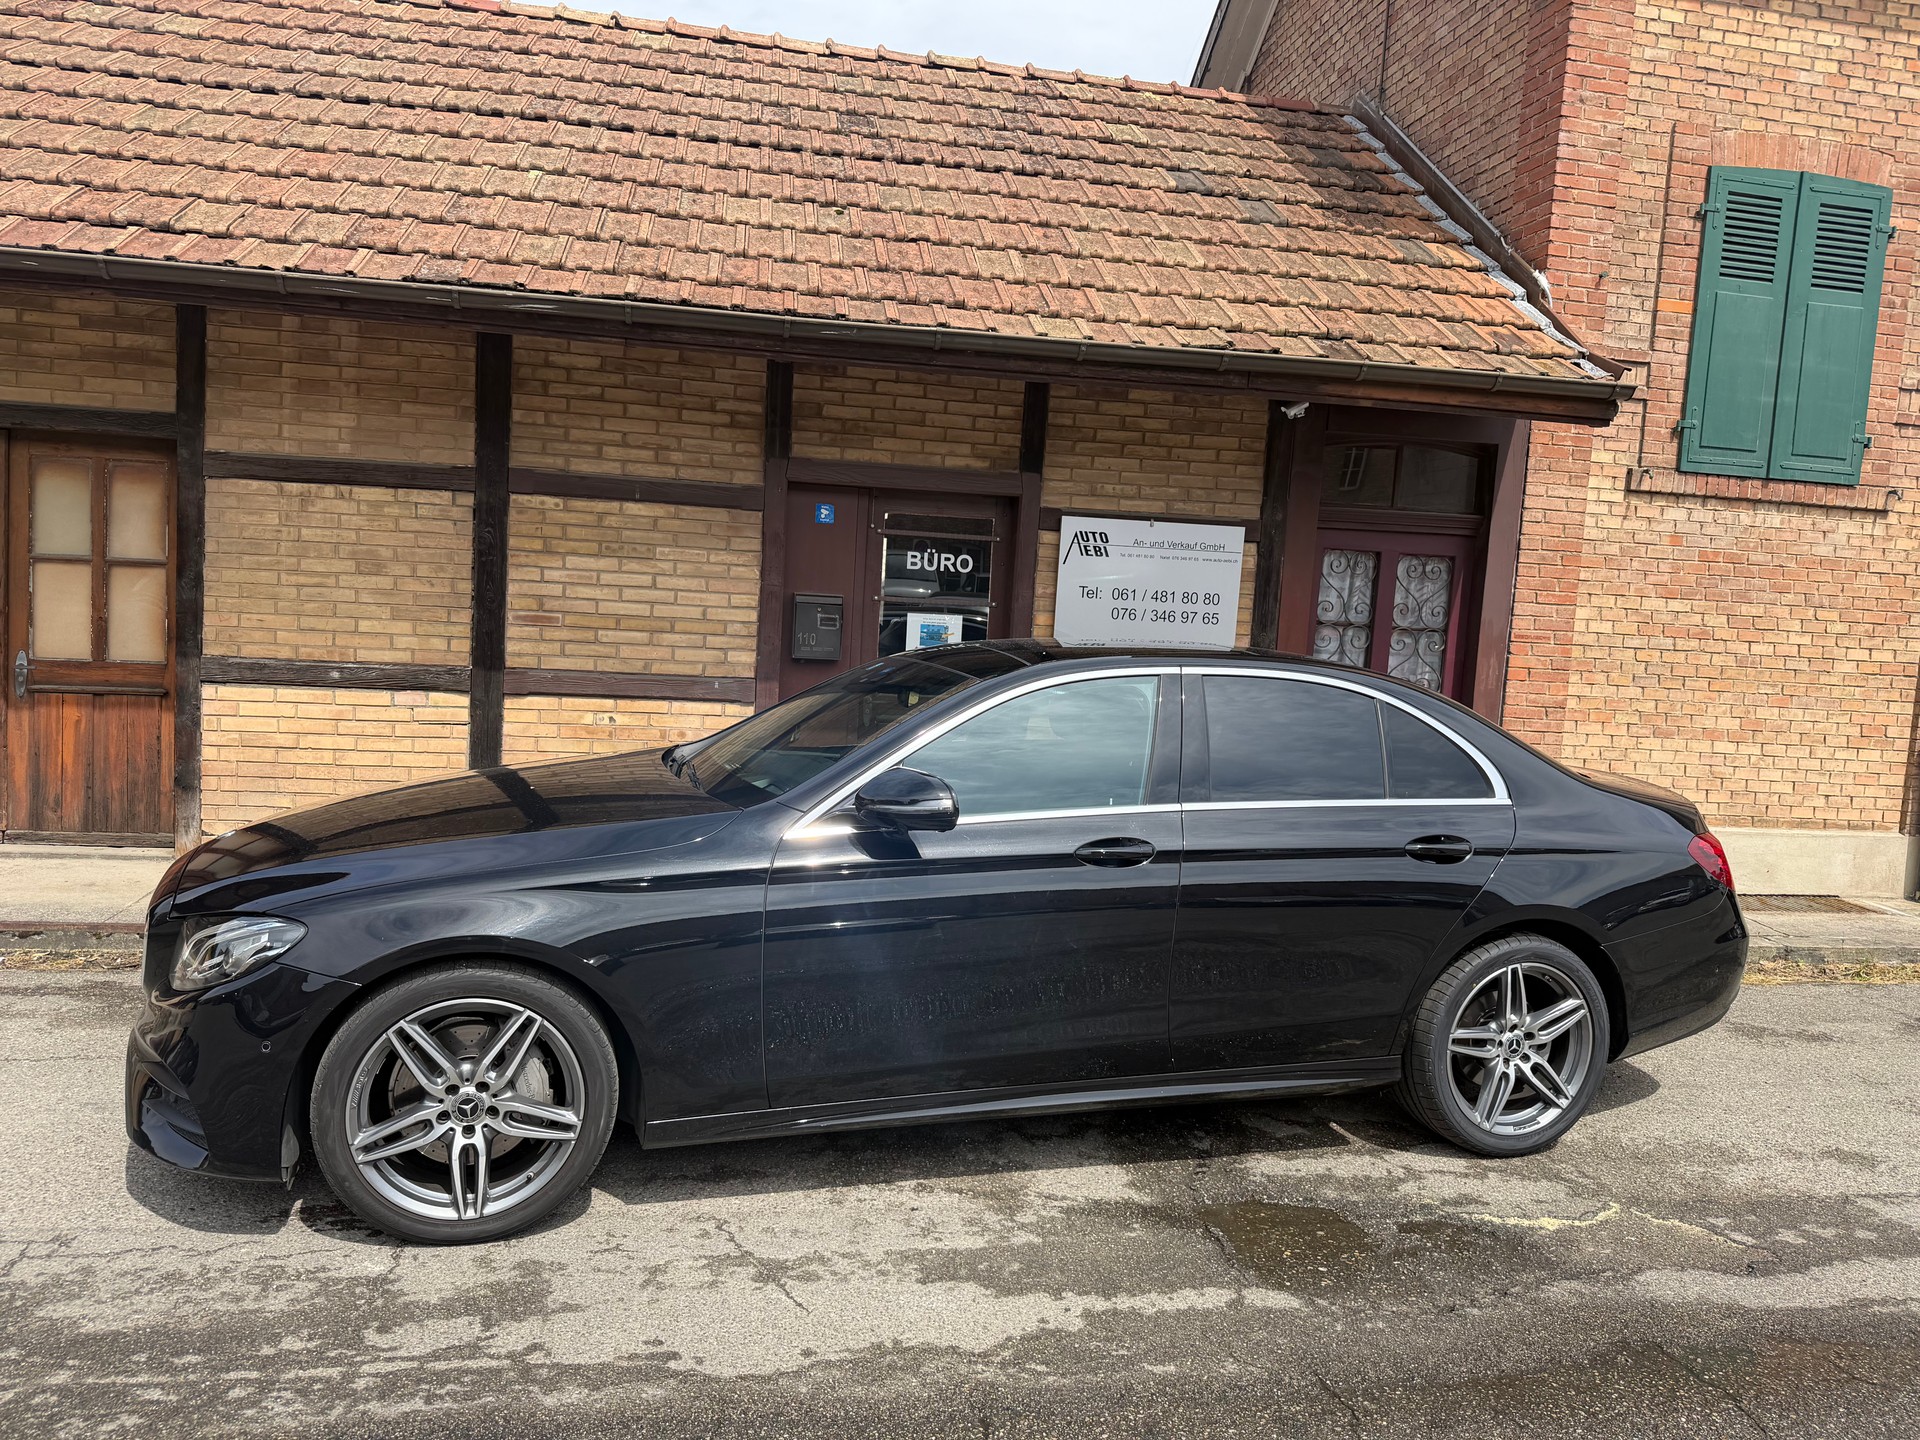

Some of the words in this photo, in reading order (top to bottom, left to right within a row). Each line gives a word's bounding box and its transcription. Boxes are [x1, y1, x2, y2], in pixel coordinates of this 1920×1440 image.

[1132, 538, 1147, 546] An-
[1149, 540, 1165, 548] und
[1166, 540, 1198, 550] Verkauf
[1199, 542, 1226, 551] GmbH
[906, 548, 974, 574] BÜRO
[1079, 586, 1102, 600] Tel:
[1111, 587, 1137, 602] 061
[1141, 589, 1148, 602] /
[1150, 589, 1176, 603] 481
[1181, 591, 1199, 605] 80
[1203, 593, 1220, 606] 80
[1111, 607, 1137, 621] 076
[1140, 608, 1147, 621] /
[1150, 609, 1176, 623] 346
[1180, 611, 1198, 625] 97
[1202, 612, 1220, 625] 65
[797, 632, 816, 646] 110
